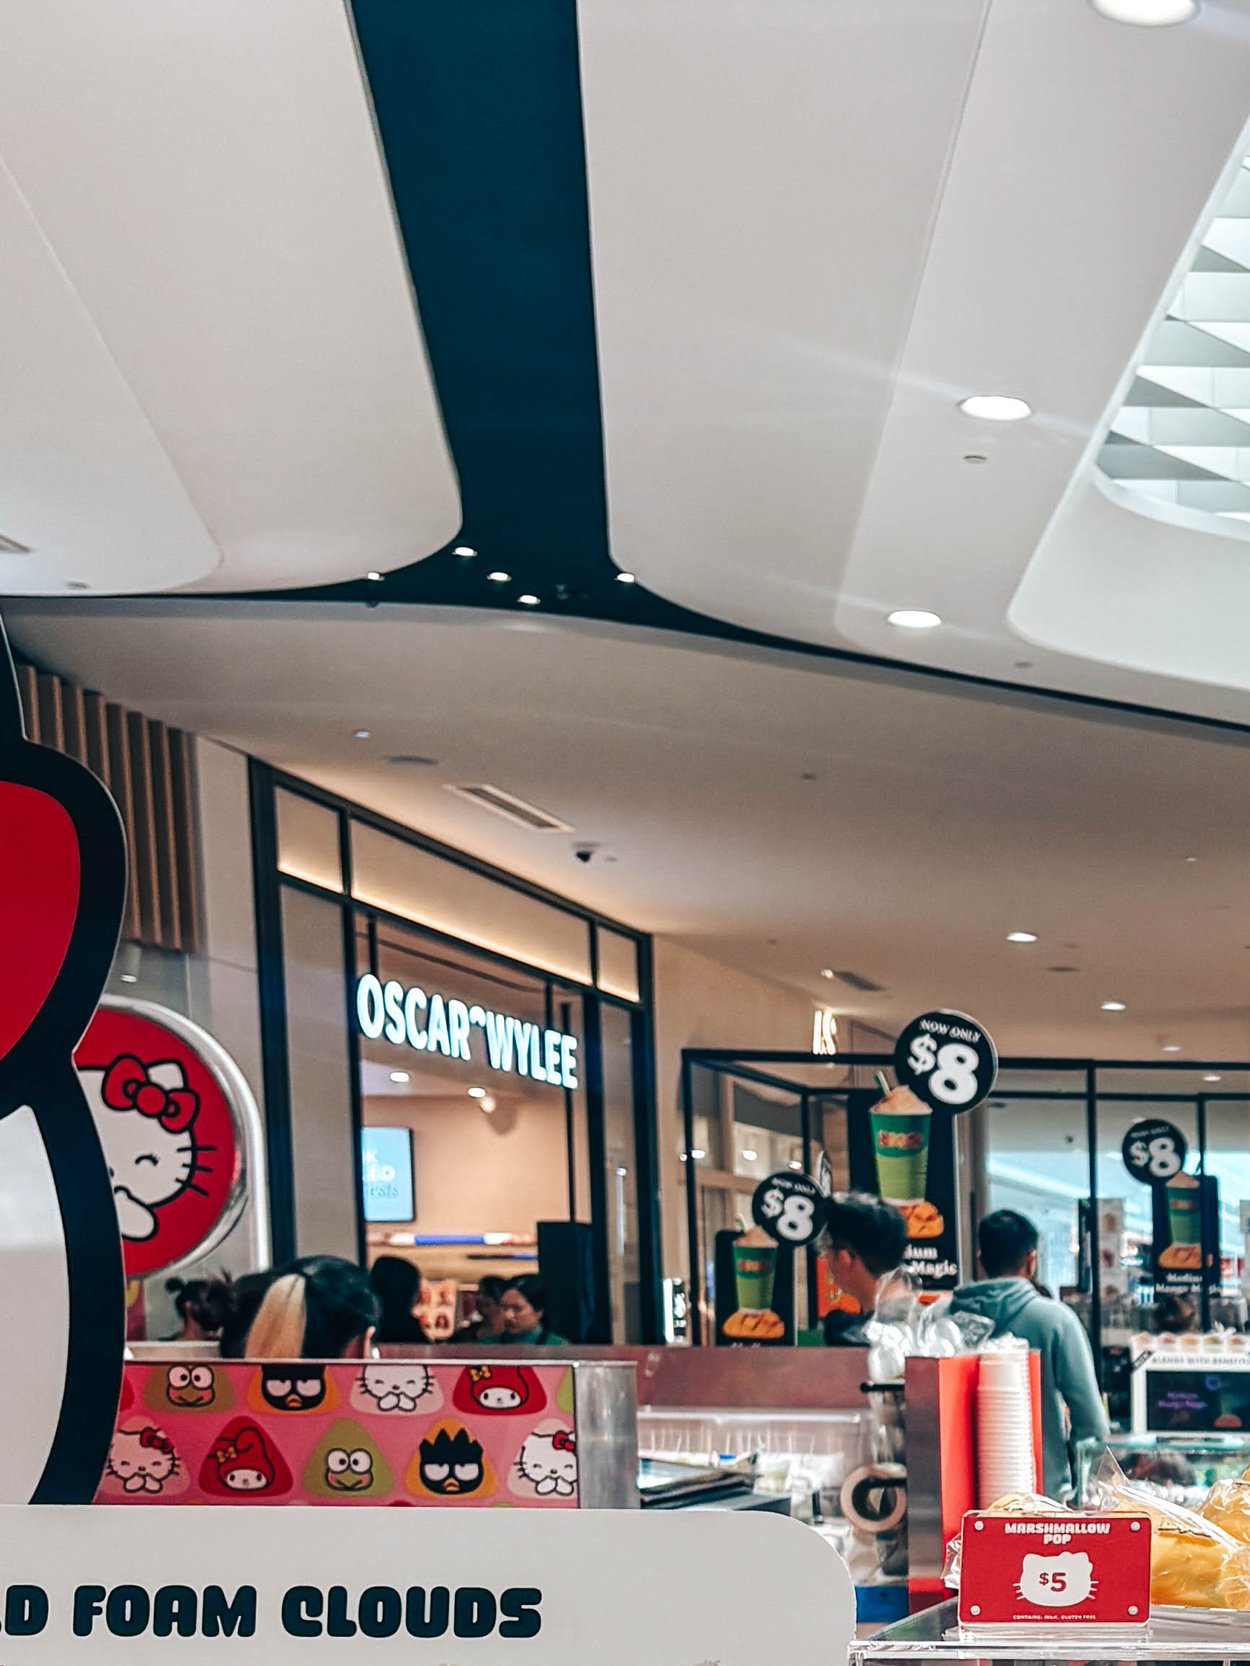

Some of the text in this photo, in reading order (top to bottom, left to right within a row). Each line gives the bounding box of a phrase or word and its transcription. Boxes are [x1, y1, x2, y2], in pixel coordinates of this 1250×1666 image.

[357, 973, 578, 1089] OSCAR WYLEE
[907, 1033, 979, 1104] $8
[1130, 1137, 1181, 1177] $8
[760, 1187, 815, 1242] $8
[1004, 1523, 1111, 1535] MARSHMALLOW
[1043, 1534, 1072, 1545] POP
[1039, 1572, 1067, 1592] $5
[72, 1585, 257, 1638] FOAM
[281, 1586, 543, 1638] CLOUDS
